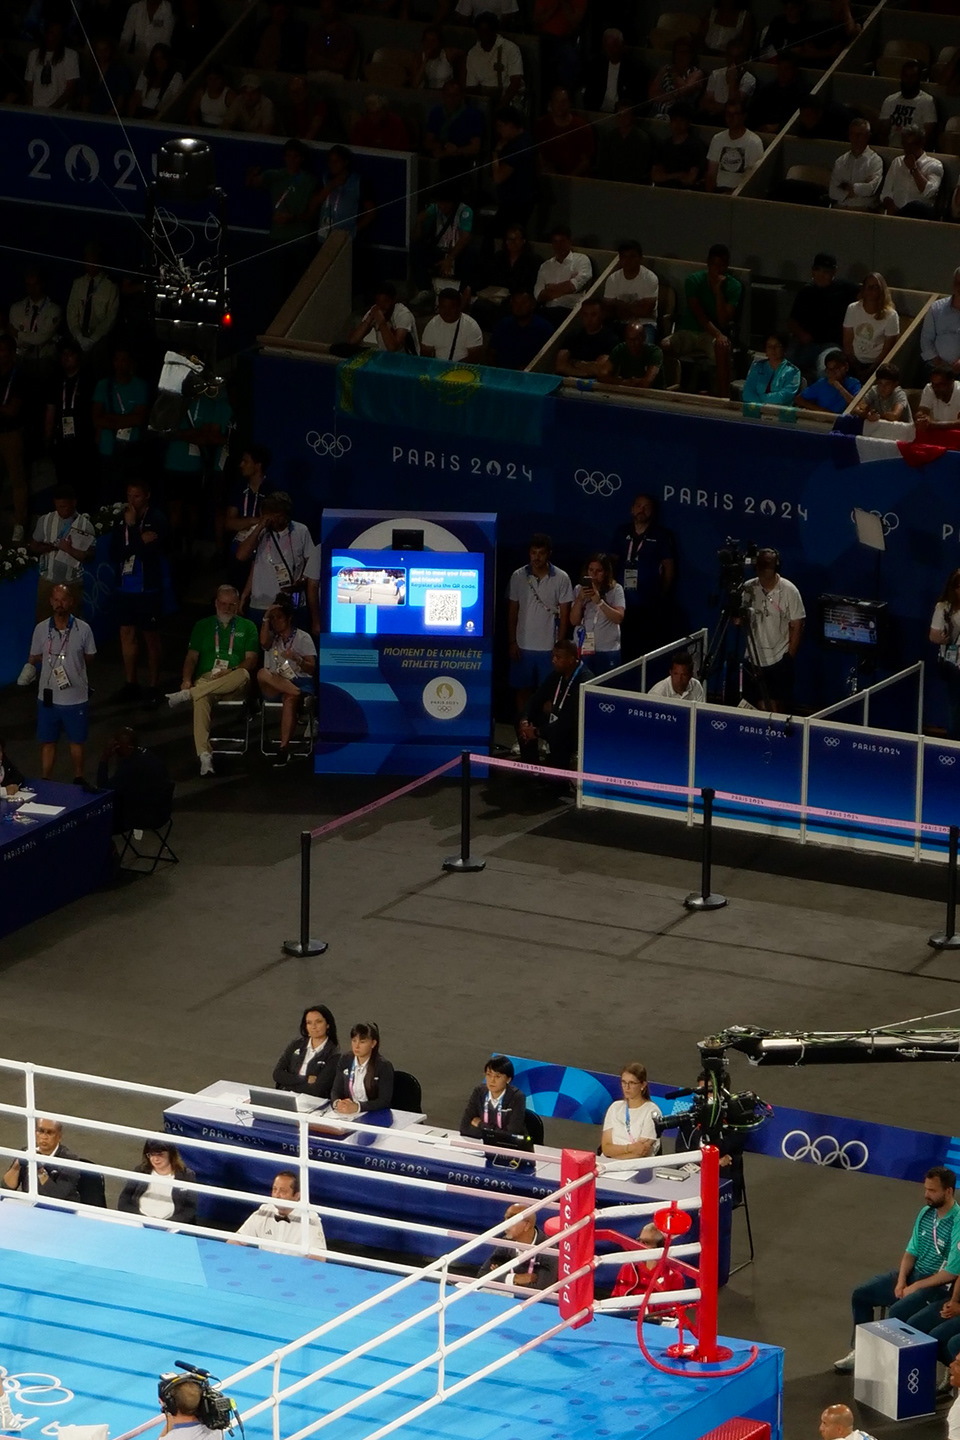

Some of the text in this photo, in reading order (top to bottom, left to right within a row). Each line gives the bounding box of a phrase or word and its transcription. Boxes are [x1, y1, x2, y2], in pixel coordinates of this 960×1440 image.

[26, 137, 157, 191] 202
[470, 457, 533, 482] 2024
[744, 497, 808, 522] 2024
[383, 647, 425, 657] MOMENT
[426, 649, 438, 658] DE
[401, 659, 483, 671] ATHLETE MOMENT
[654, 712, 678, 723] 2024
[878, 746, 901, 756] 2024
[317, 1149, 347, 1161] 2024
[400, 1162, 429, 1176] 2024
[483, 1178, 513, 1191] 2024
